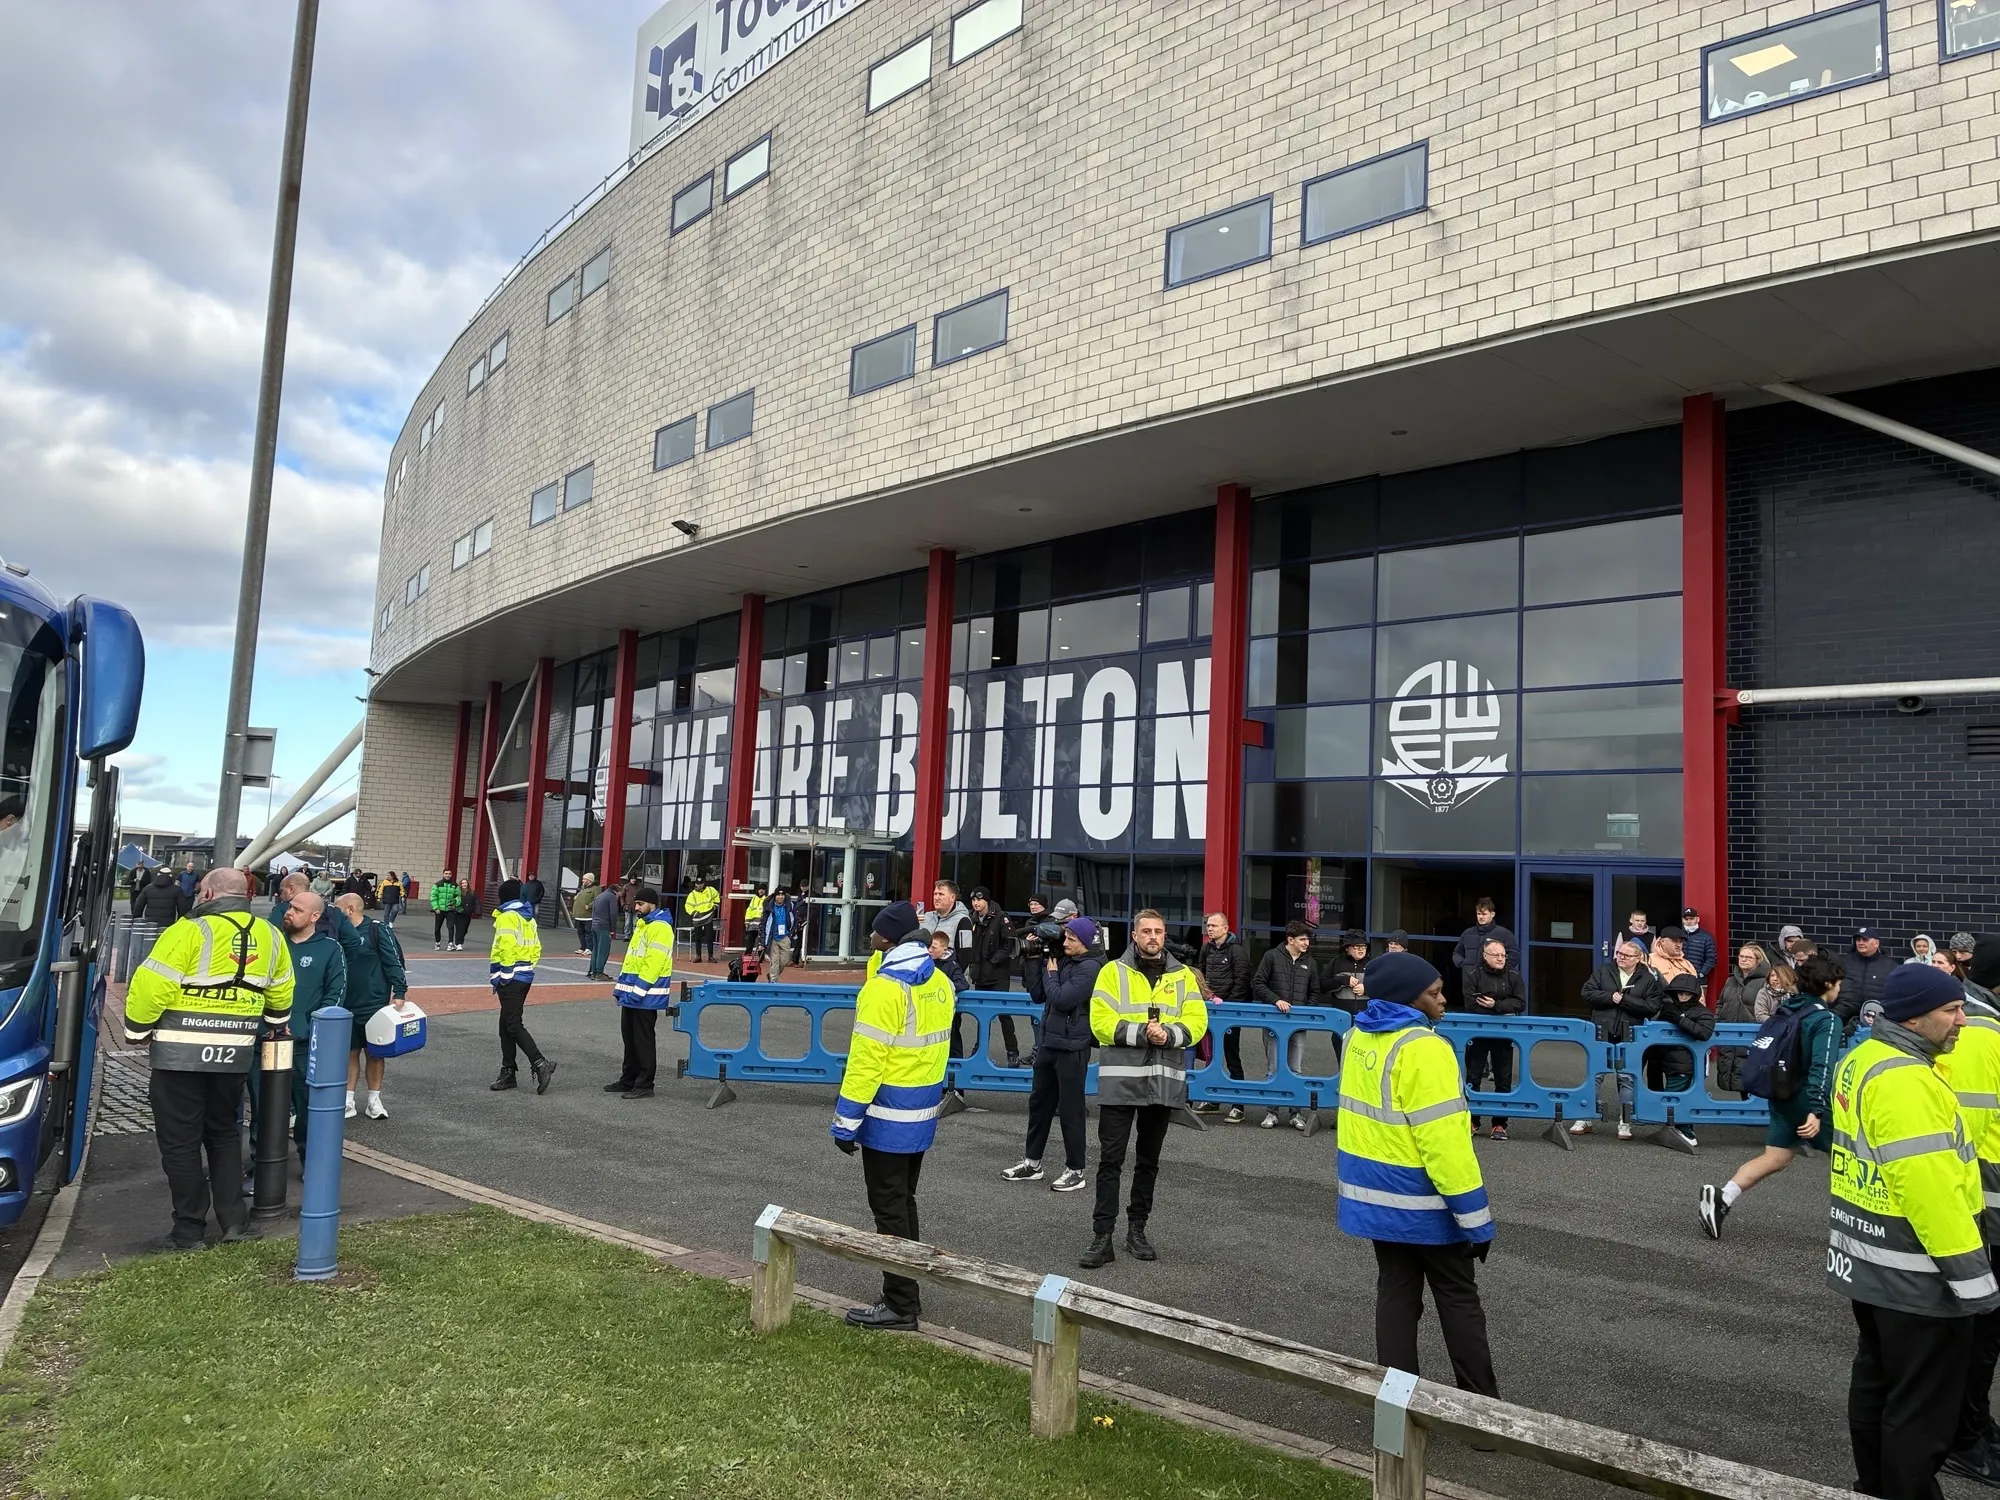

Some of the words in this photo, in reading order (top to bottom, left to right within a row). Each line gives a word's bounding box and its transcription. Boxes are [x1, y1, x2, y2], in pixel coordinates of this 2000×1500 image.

[681, 108, 700, 126] Products
[661, 715, 728, 841] WE
[751, 698, 852, 828] ARE
[874, 656, 1212, 841] BOLTON
[1434, 805, 1450, 813] 1877
[182, 1017, 243, 1029] ENGAGEMENT
[201, 1046, 236, 1063] 012
[1856, 1218, 1886, 1238] TEAM
